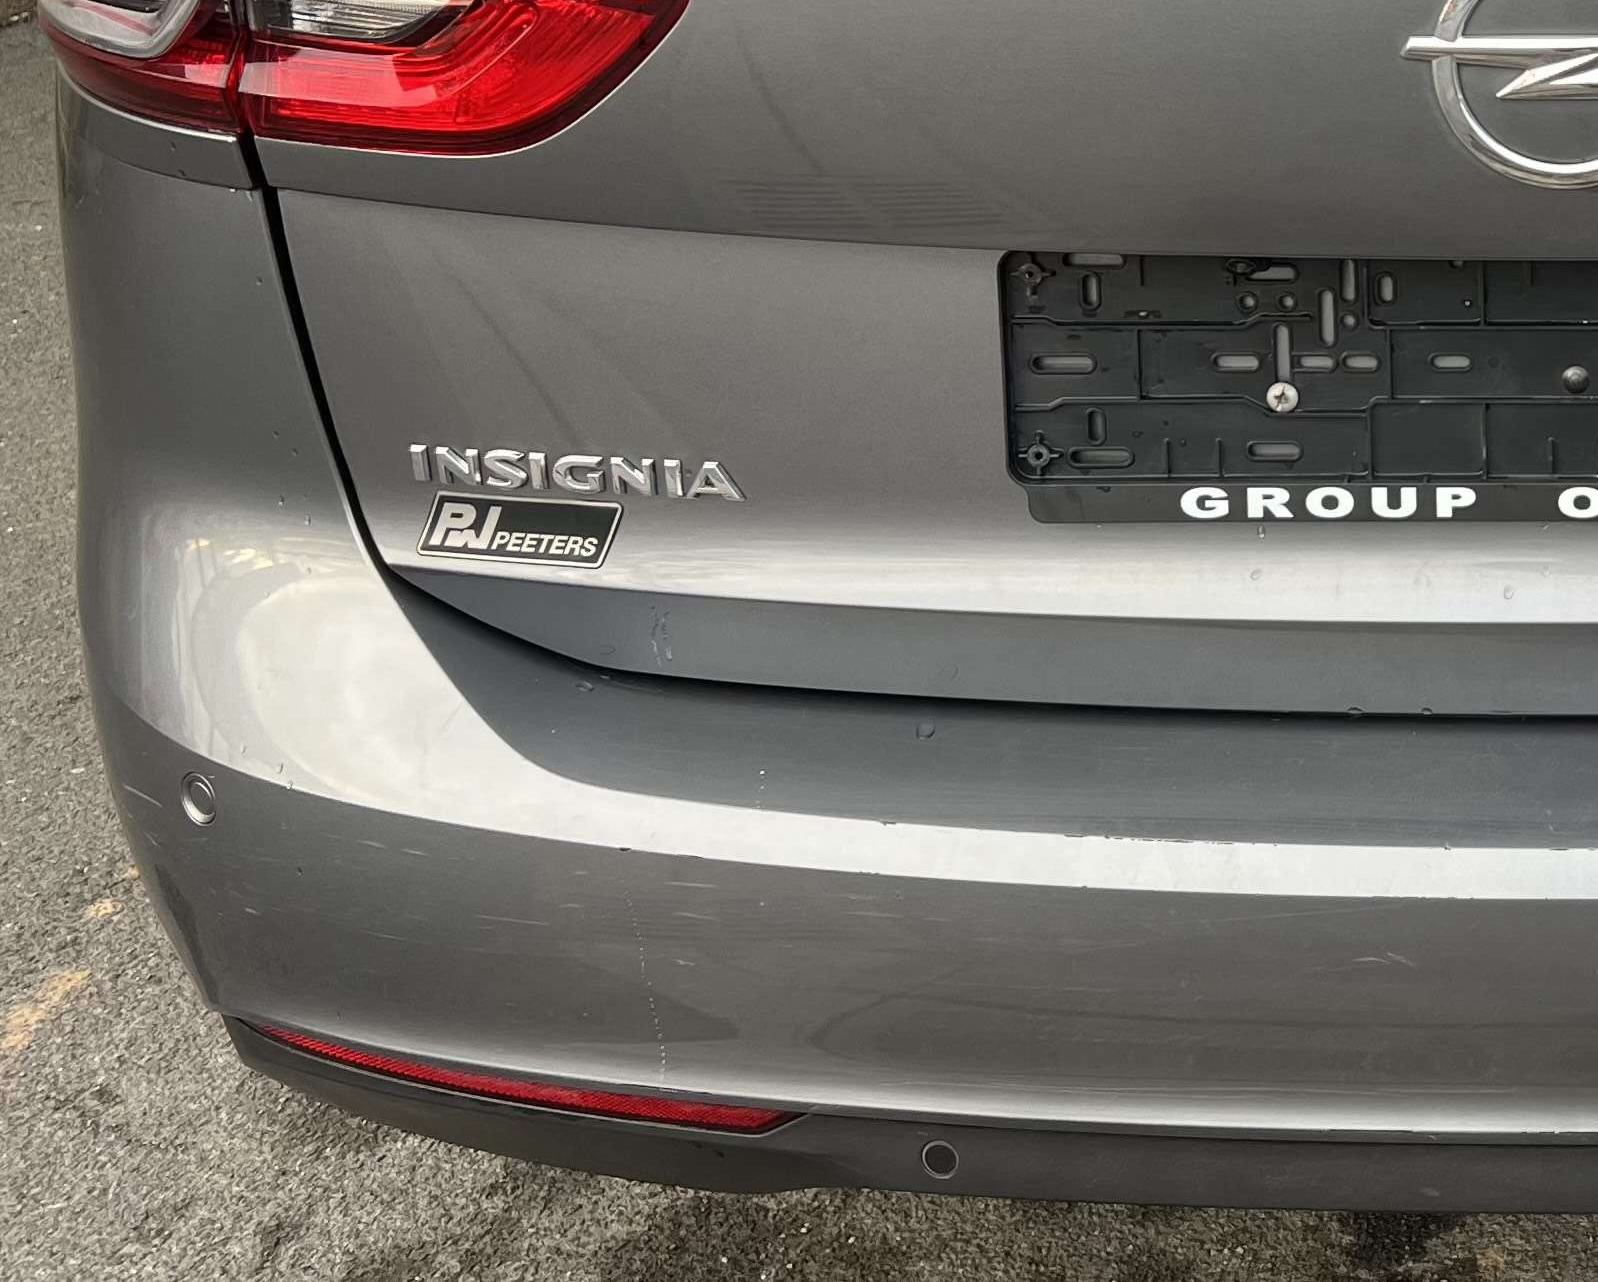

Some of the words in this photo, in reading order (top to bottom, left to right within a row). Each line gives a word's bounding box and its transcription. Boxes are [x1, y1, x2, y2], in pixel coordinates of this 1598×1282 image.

[408, 443, 748, 503] INSIGNIA
[1179, 486, 1478, 519] GROUP
[490, 530, 599, 557] PEETERS
